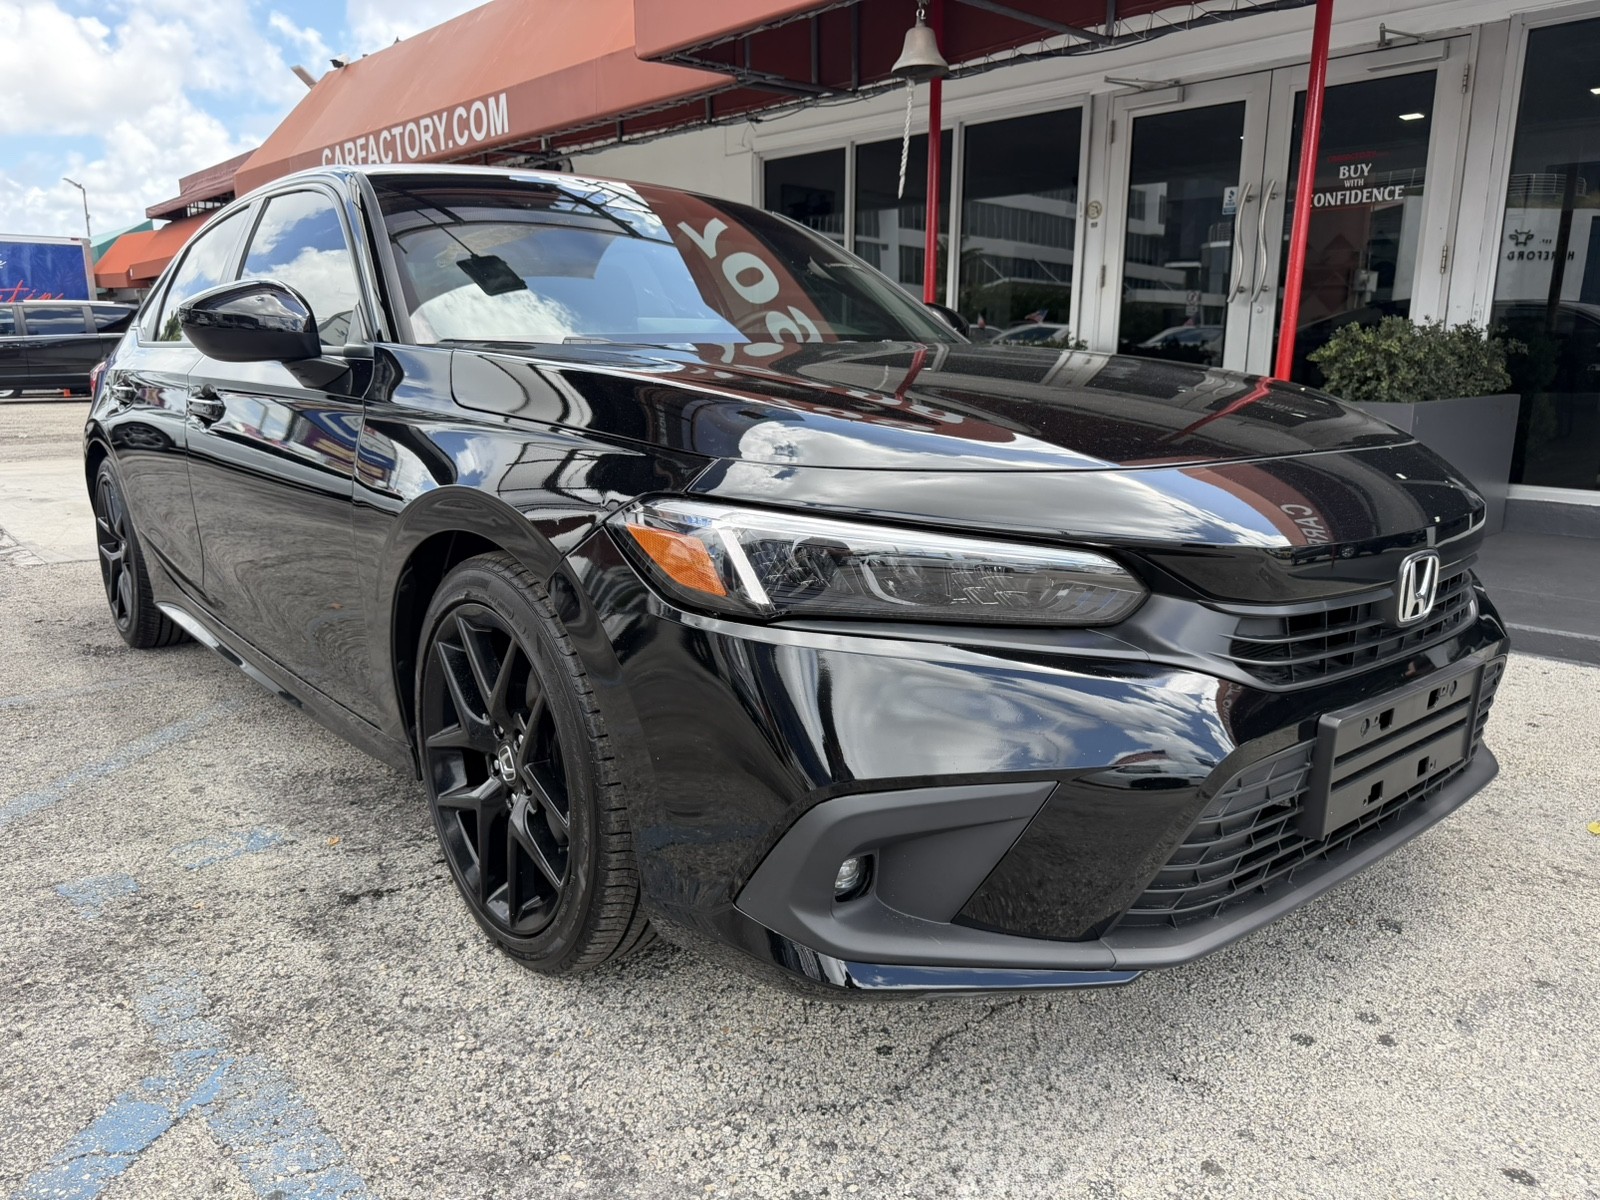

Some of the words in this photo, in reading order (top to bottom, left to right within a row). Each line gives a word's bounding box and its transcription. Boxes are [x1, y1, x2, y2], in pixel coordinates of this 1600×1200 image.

[322, 92, 509, 166] CARFACTORY.COM
[1338, 162, 1373, 179] BUY
[1344, 178, 1365, 188] WITH
[1310, 184, 1405, 208] ONFIDENCE
